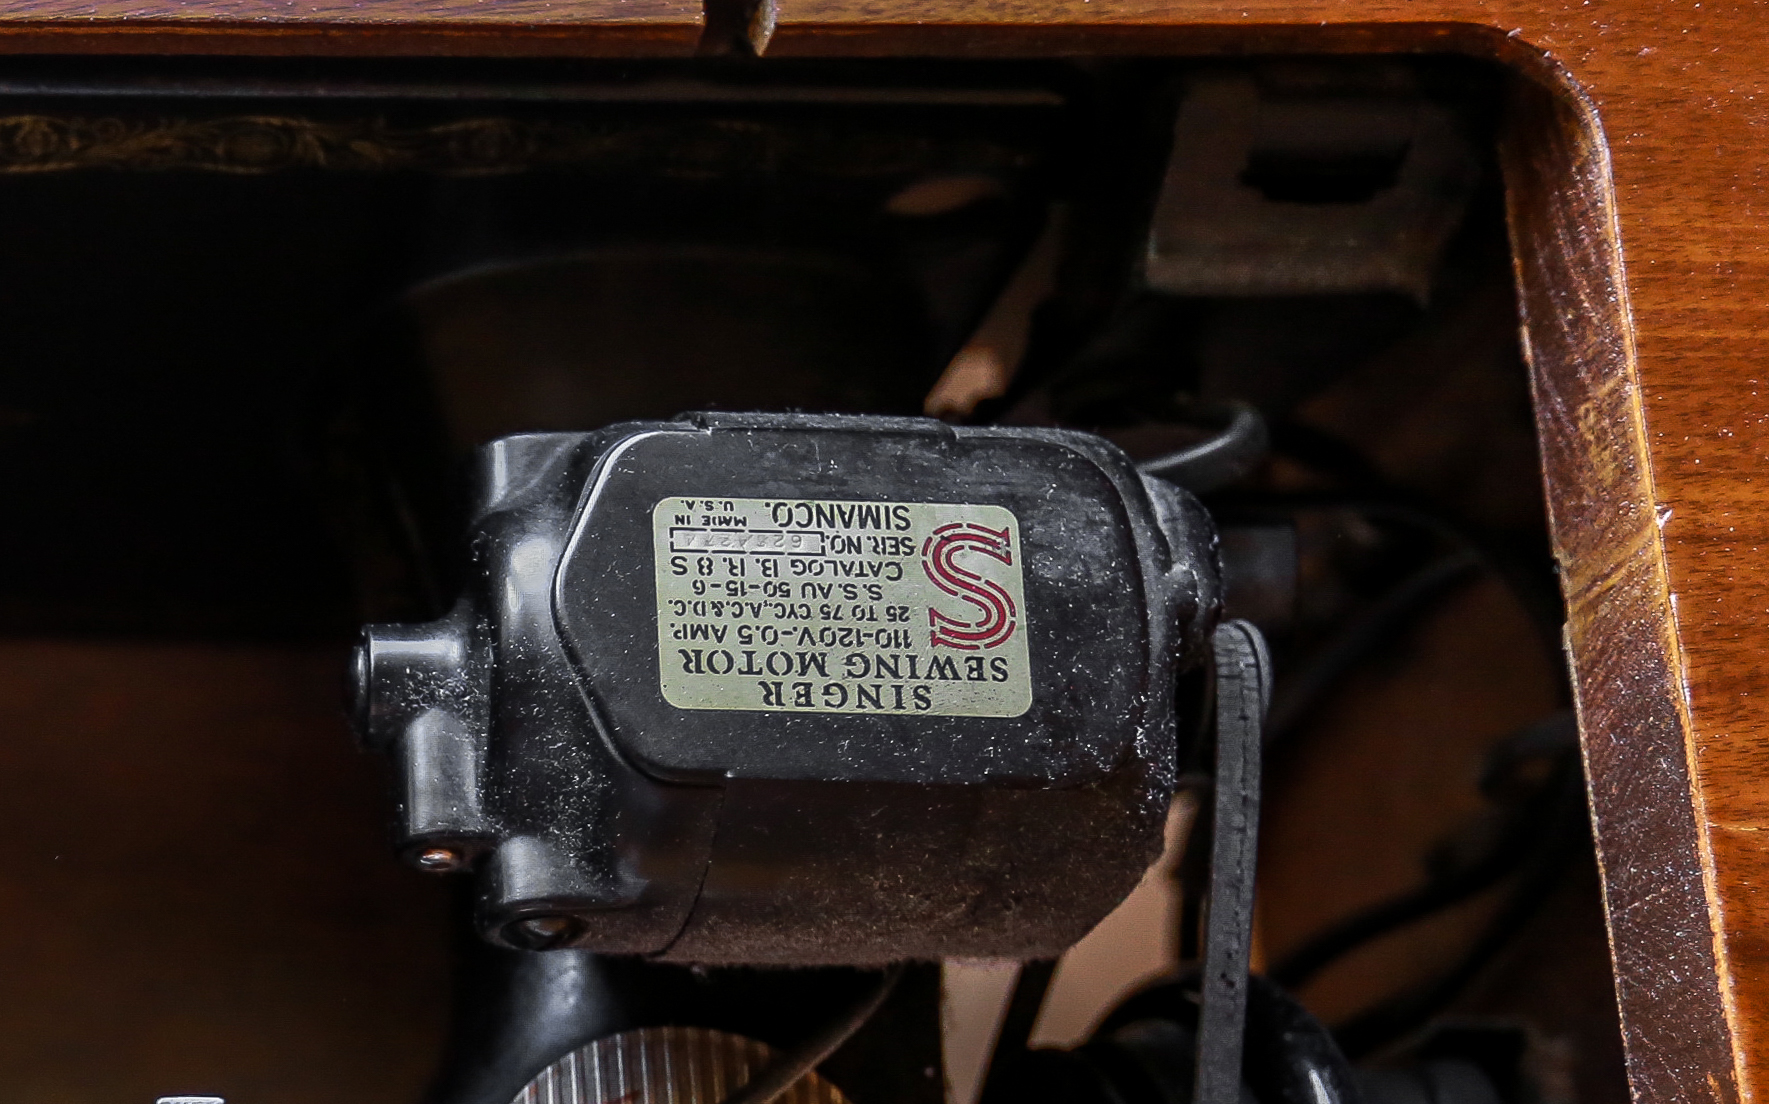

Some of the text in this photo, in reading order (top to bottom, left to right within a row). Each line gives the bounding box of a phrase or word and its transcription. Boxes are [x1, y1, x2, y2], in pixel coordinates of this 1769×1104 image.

[674, 501, 912, 531] SIMANCO. MADE IN
[825, 534, 866, 555] NO.
[866, 535, 917, 557] SER.
[790, 558, 904, 581] CATALOG
[920, 522, 1017, 651] S
[819, 603, 844, 621] 75
[851, 604, 879, 622] TO
[885, 605, 910, 622] 25
[670, 622, 729, 644] AMP.
[678, 649, 1009, 683] SEWING MOTOR
[758, 680, 932, 711] SINGER
